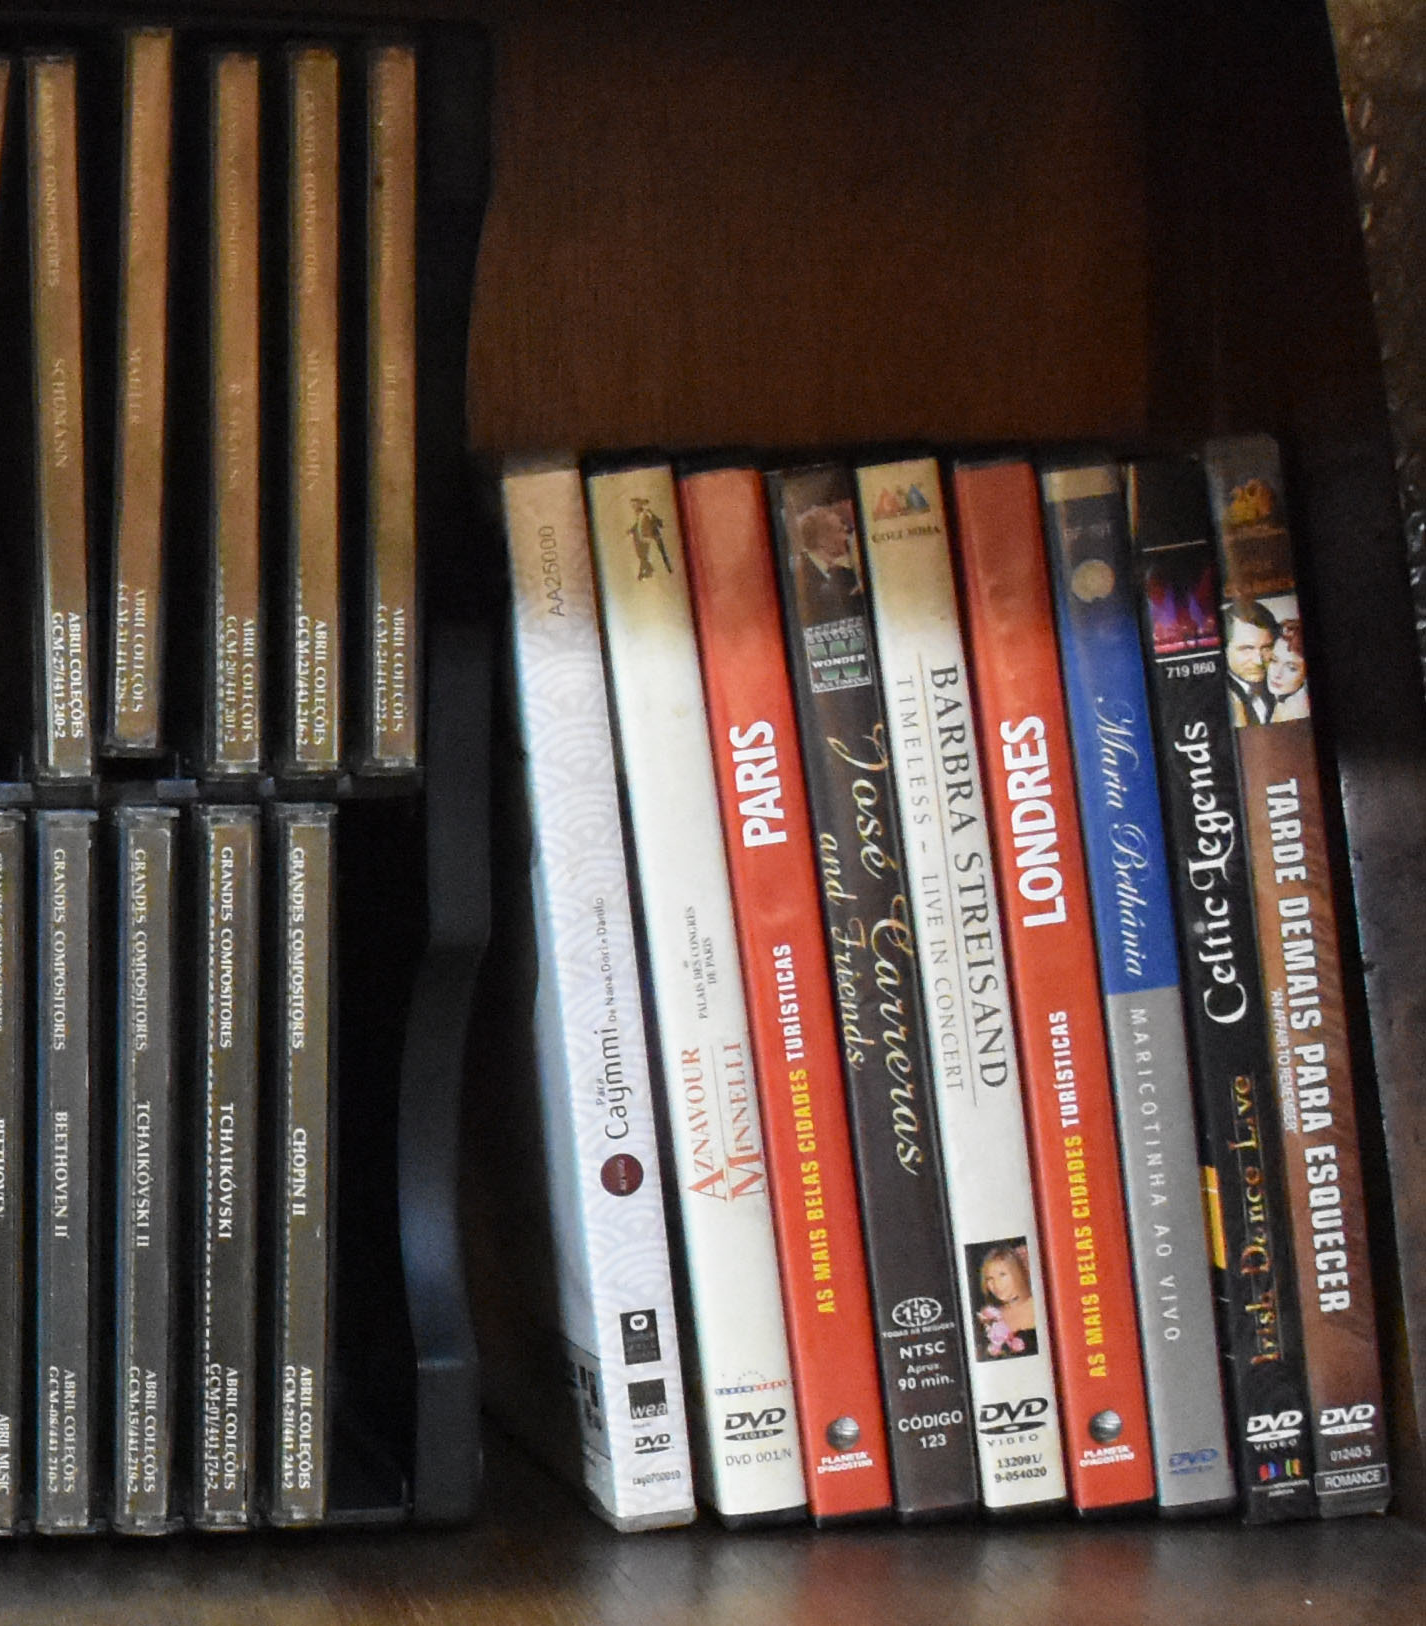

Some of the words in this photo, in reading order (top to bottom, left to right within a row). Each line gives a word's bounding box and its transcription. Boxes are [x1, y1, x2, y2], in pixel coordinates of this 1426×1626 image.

[729, 720, 788, 848] PARIS
[895, 675, 932, 826] TIMELESS
[929, 665, 981, 834] BARBRA
[1092, 696, 1139, 809] Maria
[998, 716, 1067, 928] LONDRES
[1171, 721, 1235, 891] Legends
[1265, 779, 1307, 881] TARDE
[818, 832, 858, 905] and
[920, 874, 944, 932] LIVE
[1109, 823, 1151, 978] Bethânia
[826, 724, 901, 880] José
[868, 893, 927, 1175] Carreras
[929, 941, 948, 964] IN
[952, 851, 1010, 1090] STREISAND
[1193, 896, 1248, 1024] Celtic
[1279, 899, 1320, 1030] DEMAIS
[824, 918, 878, 1071] Friends
[1272, 1009, 1289, 1048] AFFAIR
[932, 976, 964, 1092] CONCERT
[1277, 1049, 1290, 1066] TO
[592, 1024, 630, 1141] Caymmi
[789, 1068, 818, 1152] CIDADES
[1128, 1008, 1168, 1207] MARICOTINHA
[1293, 1043, 1334, 1133] PARA
[679, 1049, 727, 1202] AZNAVOUR
[721, 1042, 766, 1201] MINNELLI
[54, 1110, 70, 1218] BEETHOVEN
[136, 1099, 153, 1228] TCHAIKÓVSKI
[218, 1102, 236, 1239] TCHAIKÓVSKI
[292, 1127, 307, 1199] CHOPIN
[801, 1161, 825, 1220] BELAS
[1063, 1136, 1091, 1219] CIDADES
[54, 1224, 68, 1237] II
[136, 1235, 150, 1247] II
[292, 1203, 306, 1216] II
[1152, 1225, 1173, 1258] AO
[1302, 1144, 1350, 1314] ESQUECER
[809, 1232, 831, 1282] MAIS
[1073, 1226, 1097, 1286] BELAS
[816, 1288, 835, 1314] AS
[1080, 1298, 1103, 1346] MAIS
[1160, 1276, 1181, 1341] VIVO
[898, 1377, 916, 1391] 90
[921, 1374, 955, 1387] min.
[900, 1341, 946, 1360] NTSC
[1086, 1353, 1107, 1378] AS
[724, 1407, 787, 1431] DVD
[898, 1410, 963, 1432] CÓDIGO
[919, 1434, 947, 1448] 123
[980, 1397, 1048, 1424] DVD
[1247, 1410, 1303, 1433] DVD
[1319, 1404, 1374, 1426] DVD
[1324, 1471, 1381, 1489] ROMANCE
